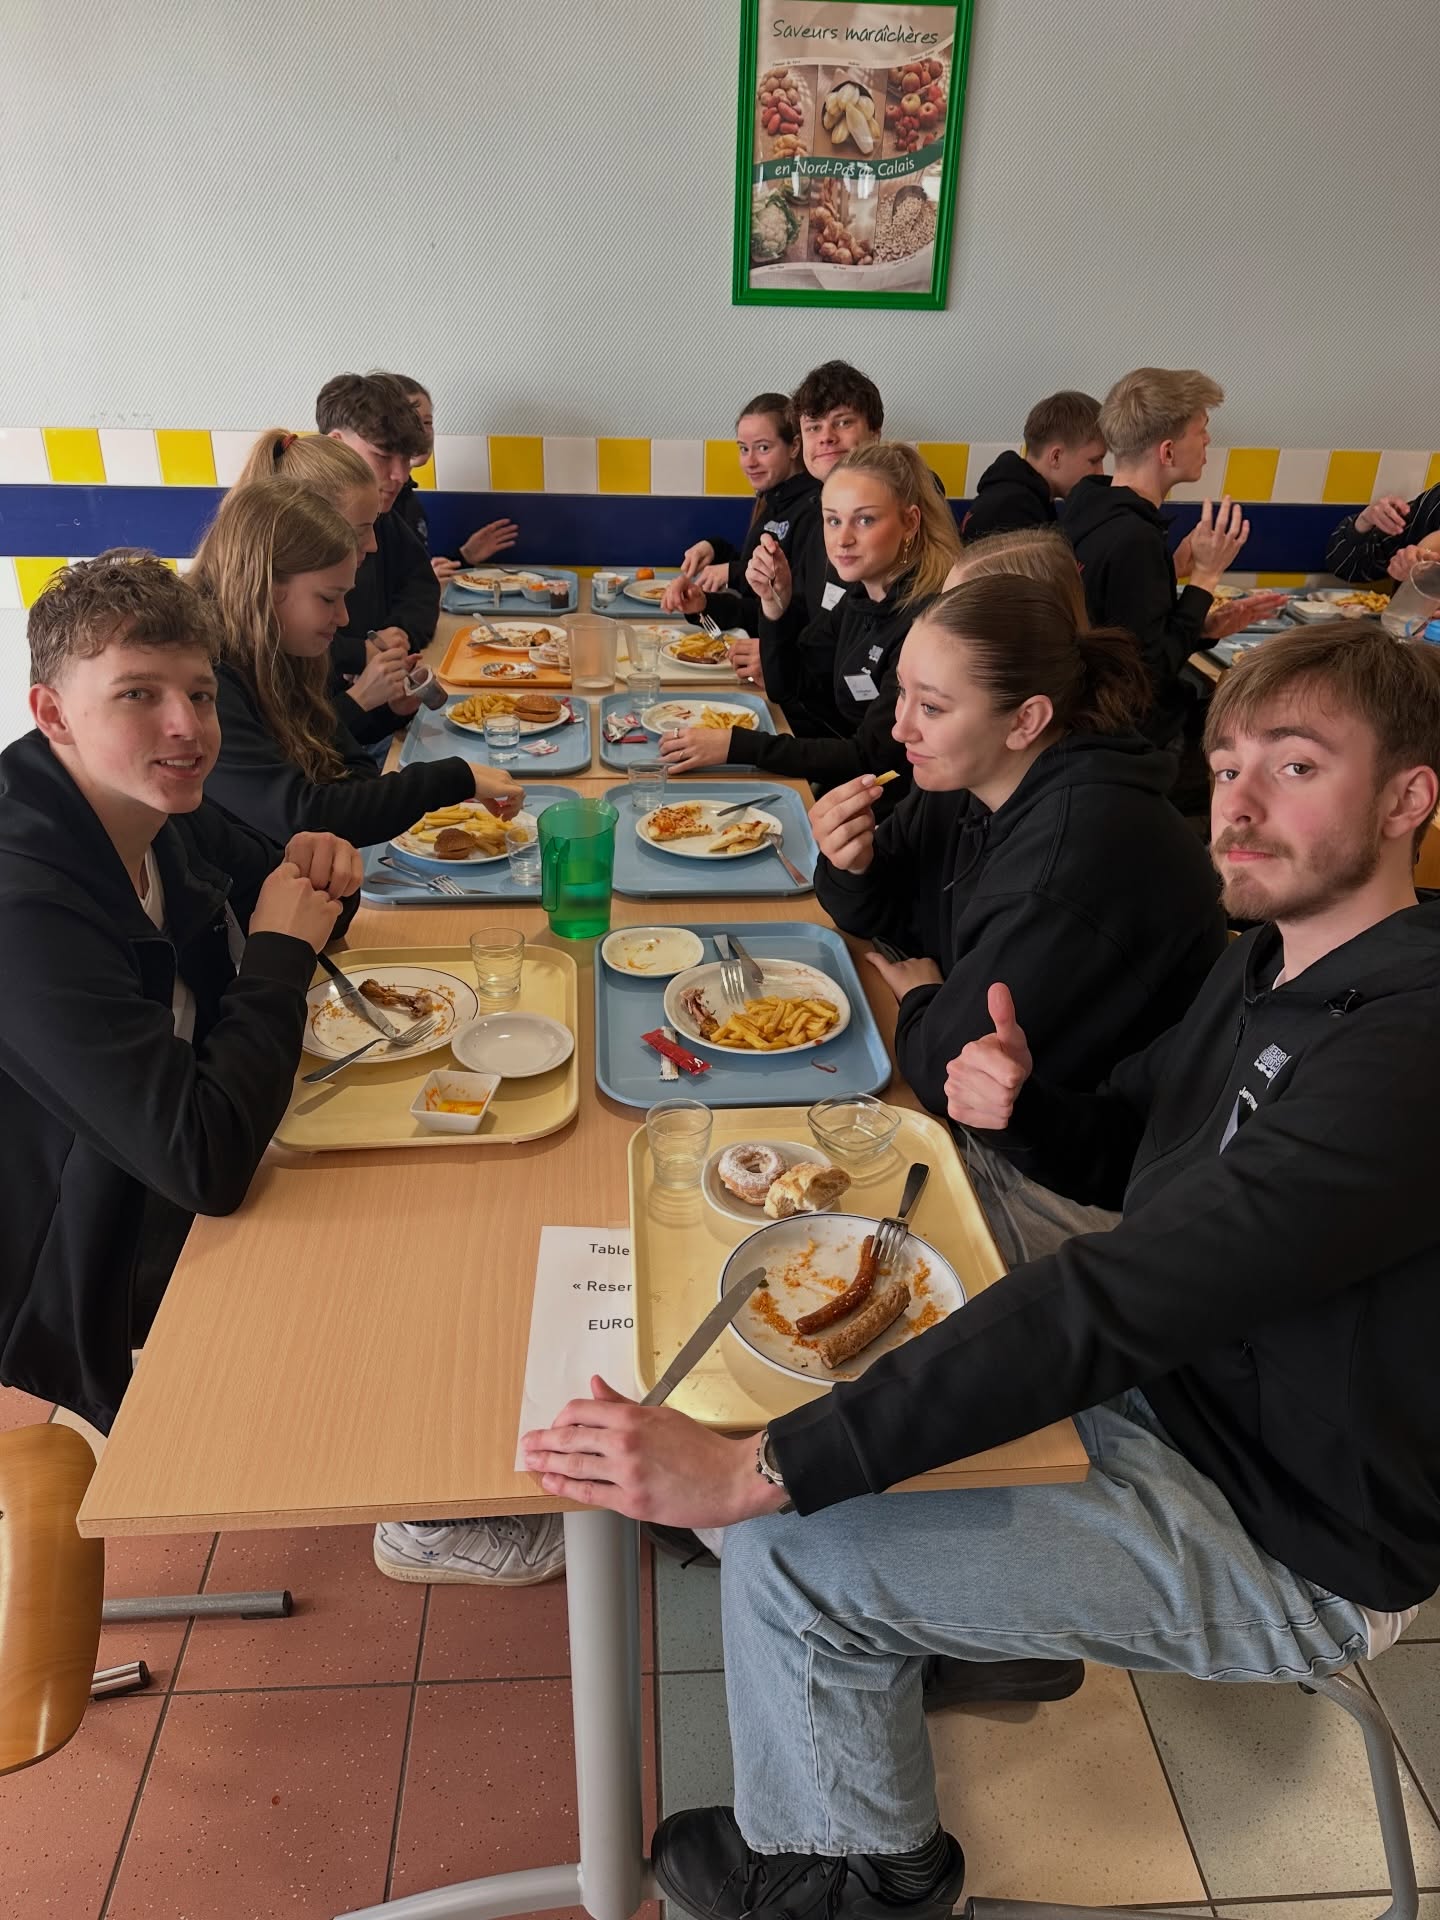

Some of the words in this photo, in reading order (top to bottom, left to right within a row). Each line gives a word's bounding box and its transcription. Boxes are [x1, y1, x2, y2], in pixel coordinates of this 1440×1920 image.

[773, 19, 838, 39] Saveurs
[845, 24, 938, 44] maraîchères
[775, 164, 790, 175] en
[795, 160, 855, 176] Nord-Pas
[878, 157, 915, 176] Calais
[589, 1243, 630, 1256] Table
[588, 1317, 634, 1330] EURO
